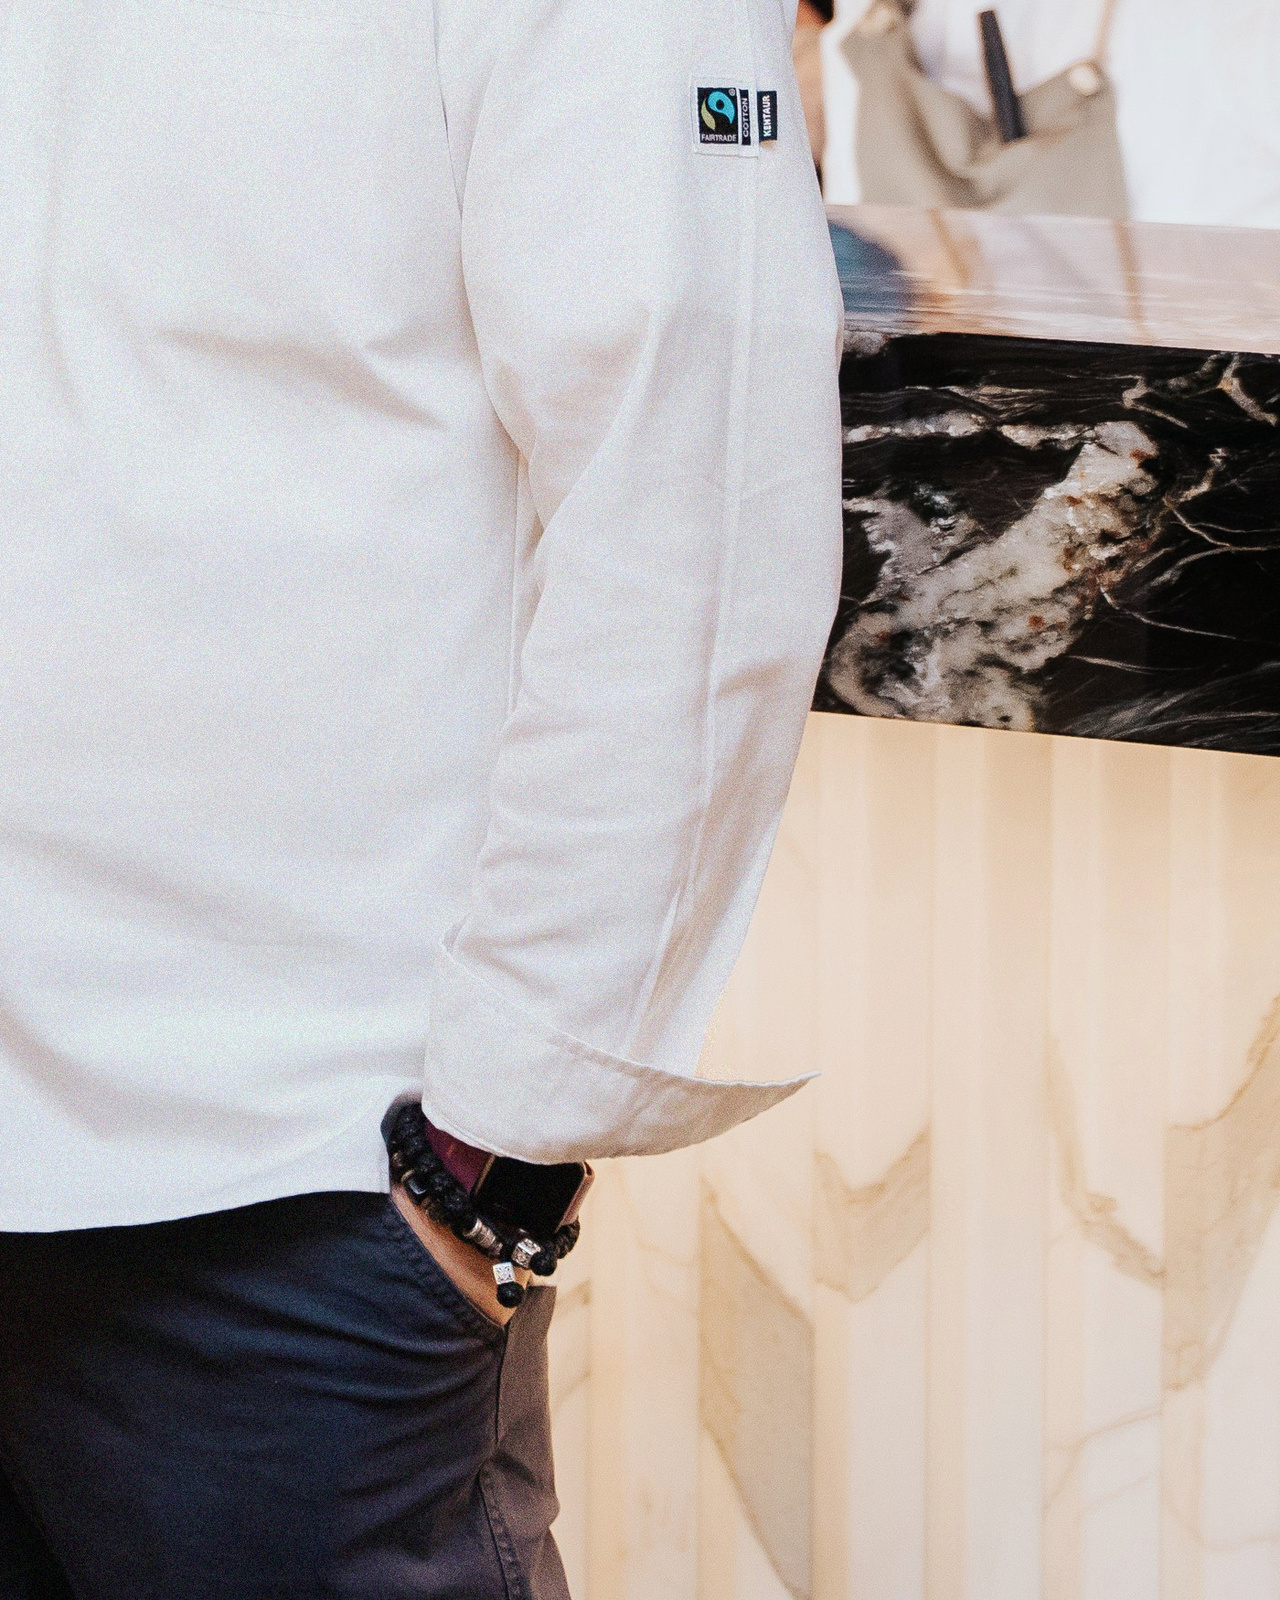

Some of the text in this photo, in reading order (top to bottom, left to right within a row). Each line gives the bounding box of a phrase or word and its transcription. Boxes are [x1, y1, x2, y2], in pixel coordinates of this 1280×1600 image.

[741, 98, 749, 138] COTTON
[762, 94, 772, 137] KENTAUR
[701, 133, 737, 142] FAIRTRADE
